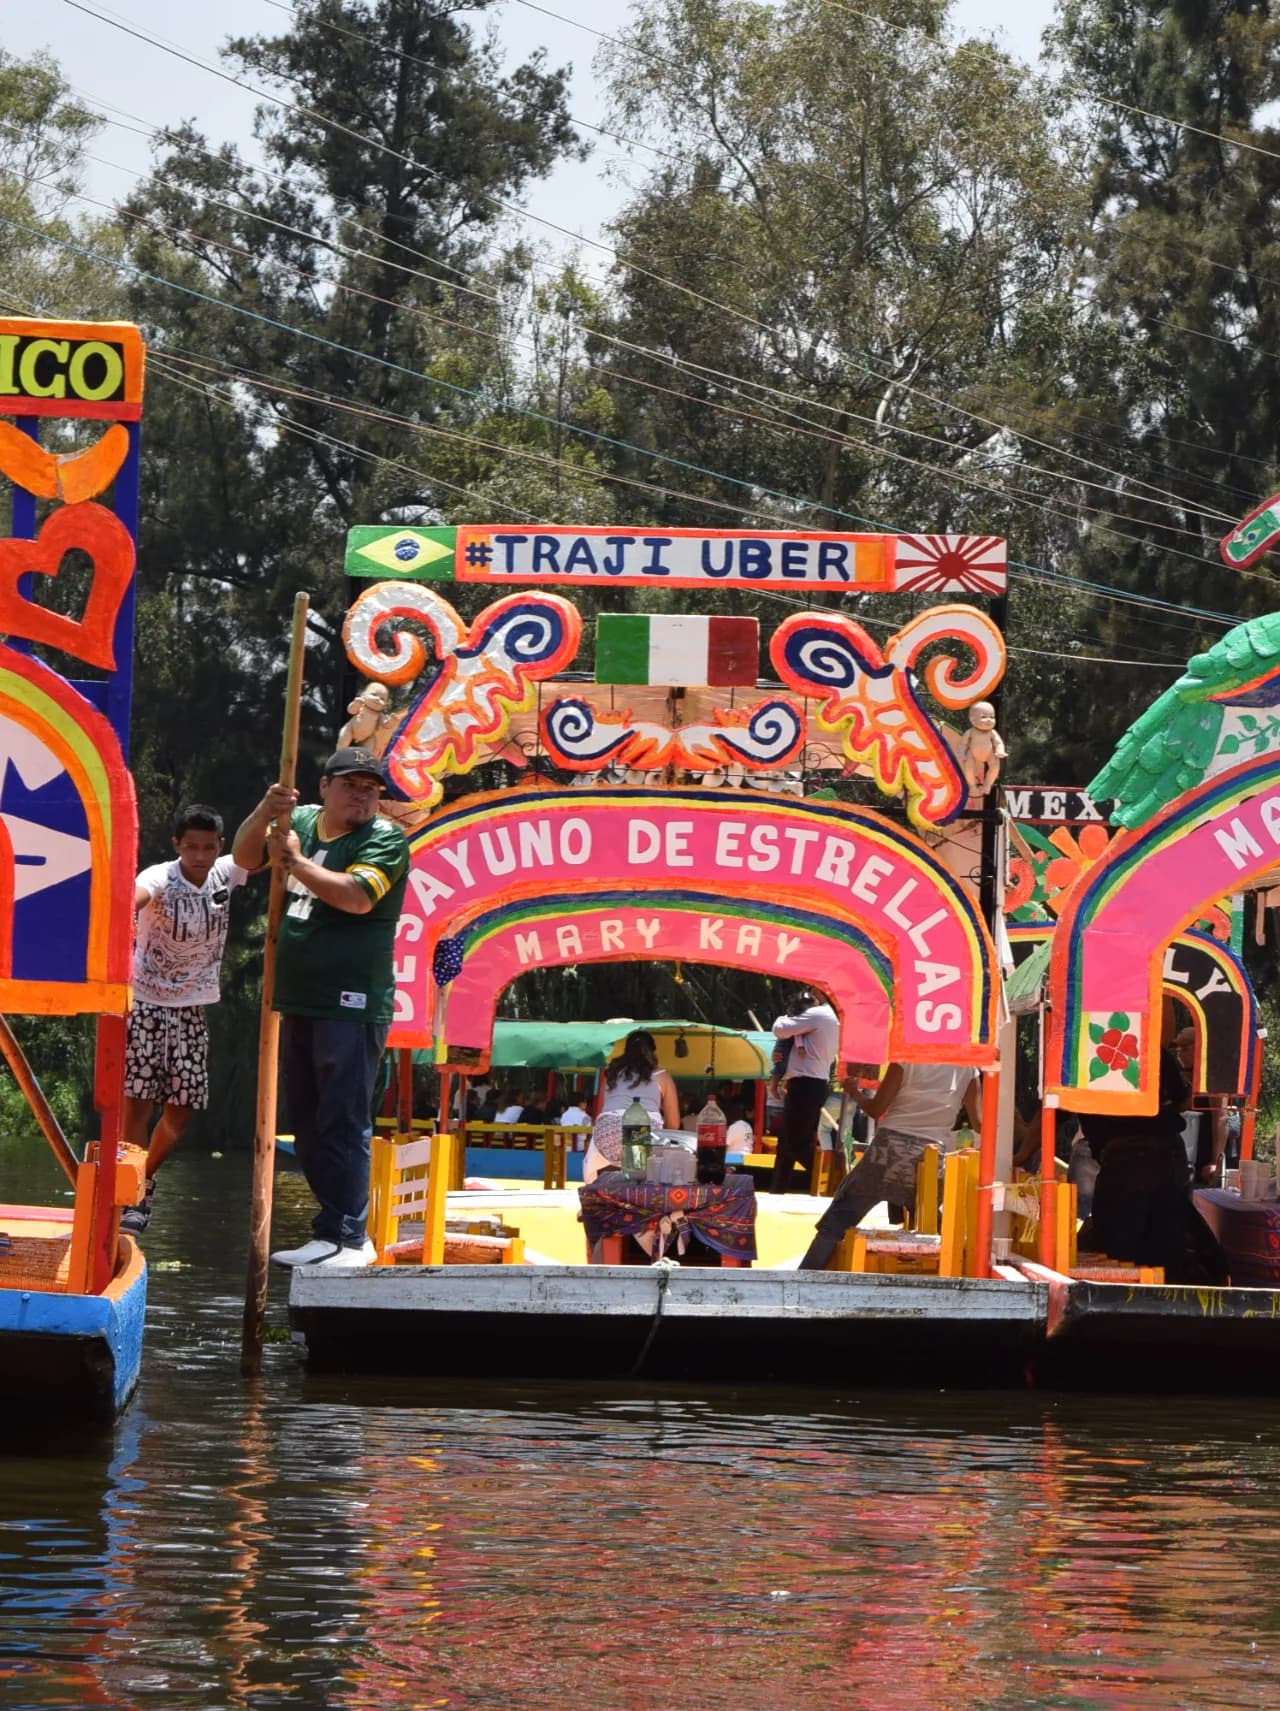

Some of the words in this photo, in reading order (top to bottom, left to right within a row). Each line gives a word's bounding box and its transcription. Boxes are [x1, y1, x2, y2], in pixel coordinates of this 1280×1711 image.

[465, 534, 671, 576] #TRAJI
[702, 539, 850, 582] UBER
[1004, 790, 1121, 820] MEX
[515, 918, 660, 964] MARY
[700, 918, 800, 963] KAY
[628, 819, 694, 867] DE
[715, 821, 962, 1033] ESTRELLAS
